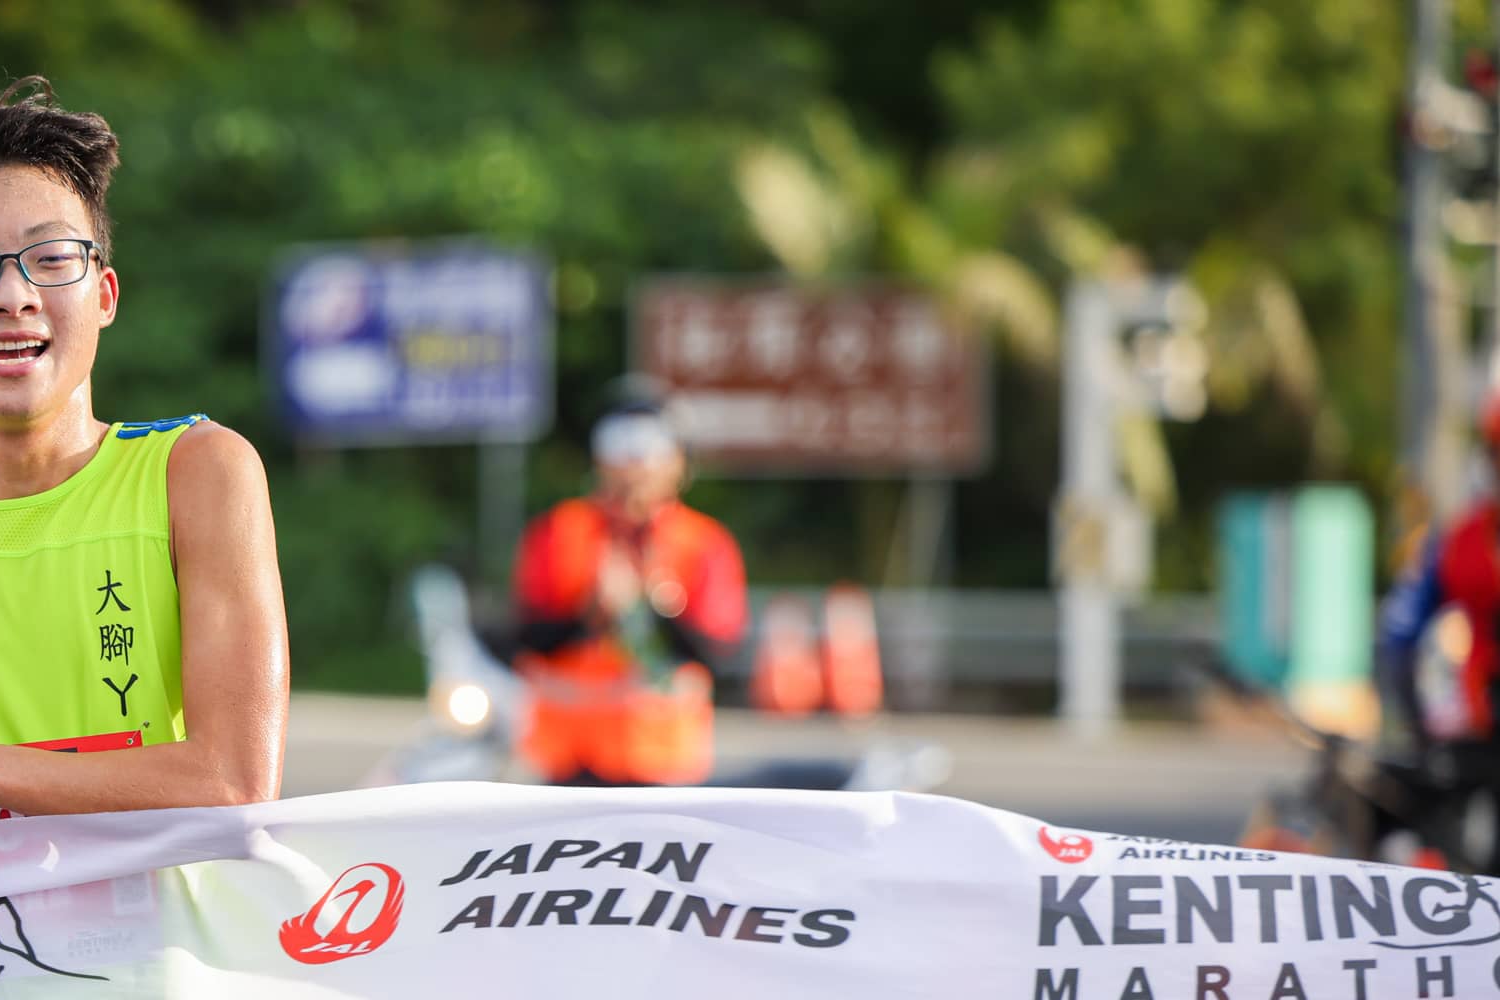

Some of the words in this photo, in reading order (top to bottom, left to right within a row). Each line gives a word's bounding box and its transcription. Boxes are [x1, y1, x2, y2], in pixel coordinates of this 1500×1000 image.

[95, 569, 139, 717] 大腳丫
[439, 839, 713, 887] JAPAN
[1058, 848, 1086, 858] JAL
[1118, 847, 1277, 861] AIRLINES
[438, 888, 856, 949] AIRLINES
[1037, 874, 1472, 947] KENTING
